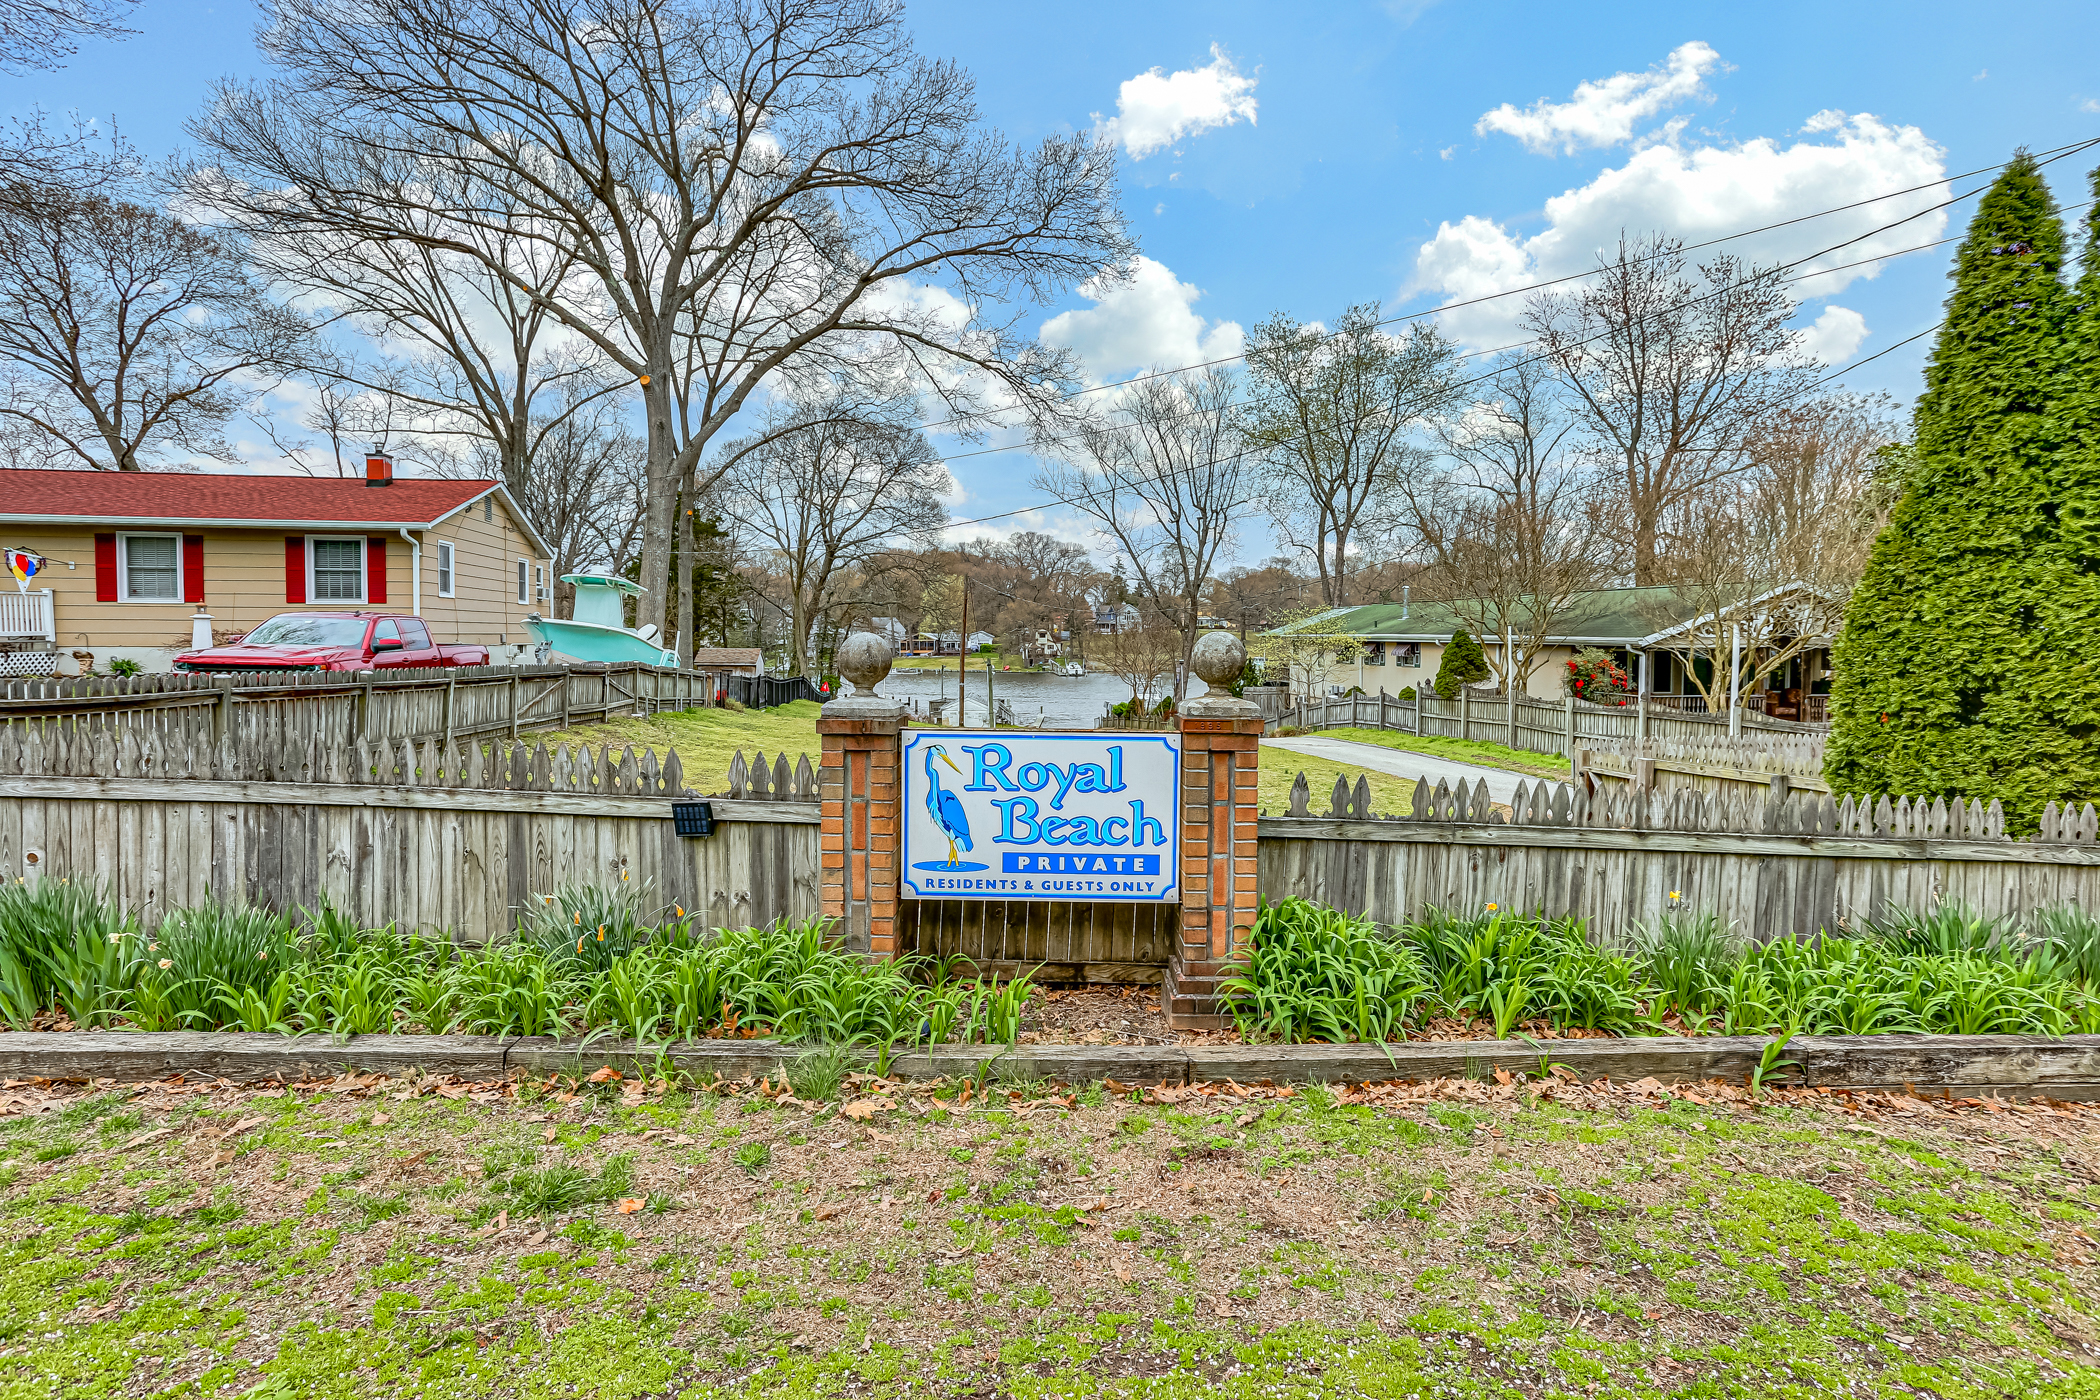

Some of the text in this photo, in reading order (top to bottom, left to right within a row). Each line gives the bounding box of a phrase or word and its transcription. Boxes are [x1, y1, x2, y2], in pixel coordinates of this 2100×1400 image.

[961, 743, 1127, 810] Royal
[991, 796, 1167, 847] Beach
[1018, 856, 1145, 872] PRIVATE
[925, 878, 1155, 892] RESIDENTS & GUESTS ONLY
